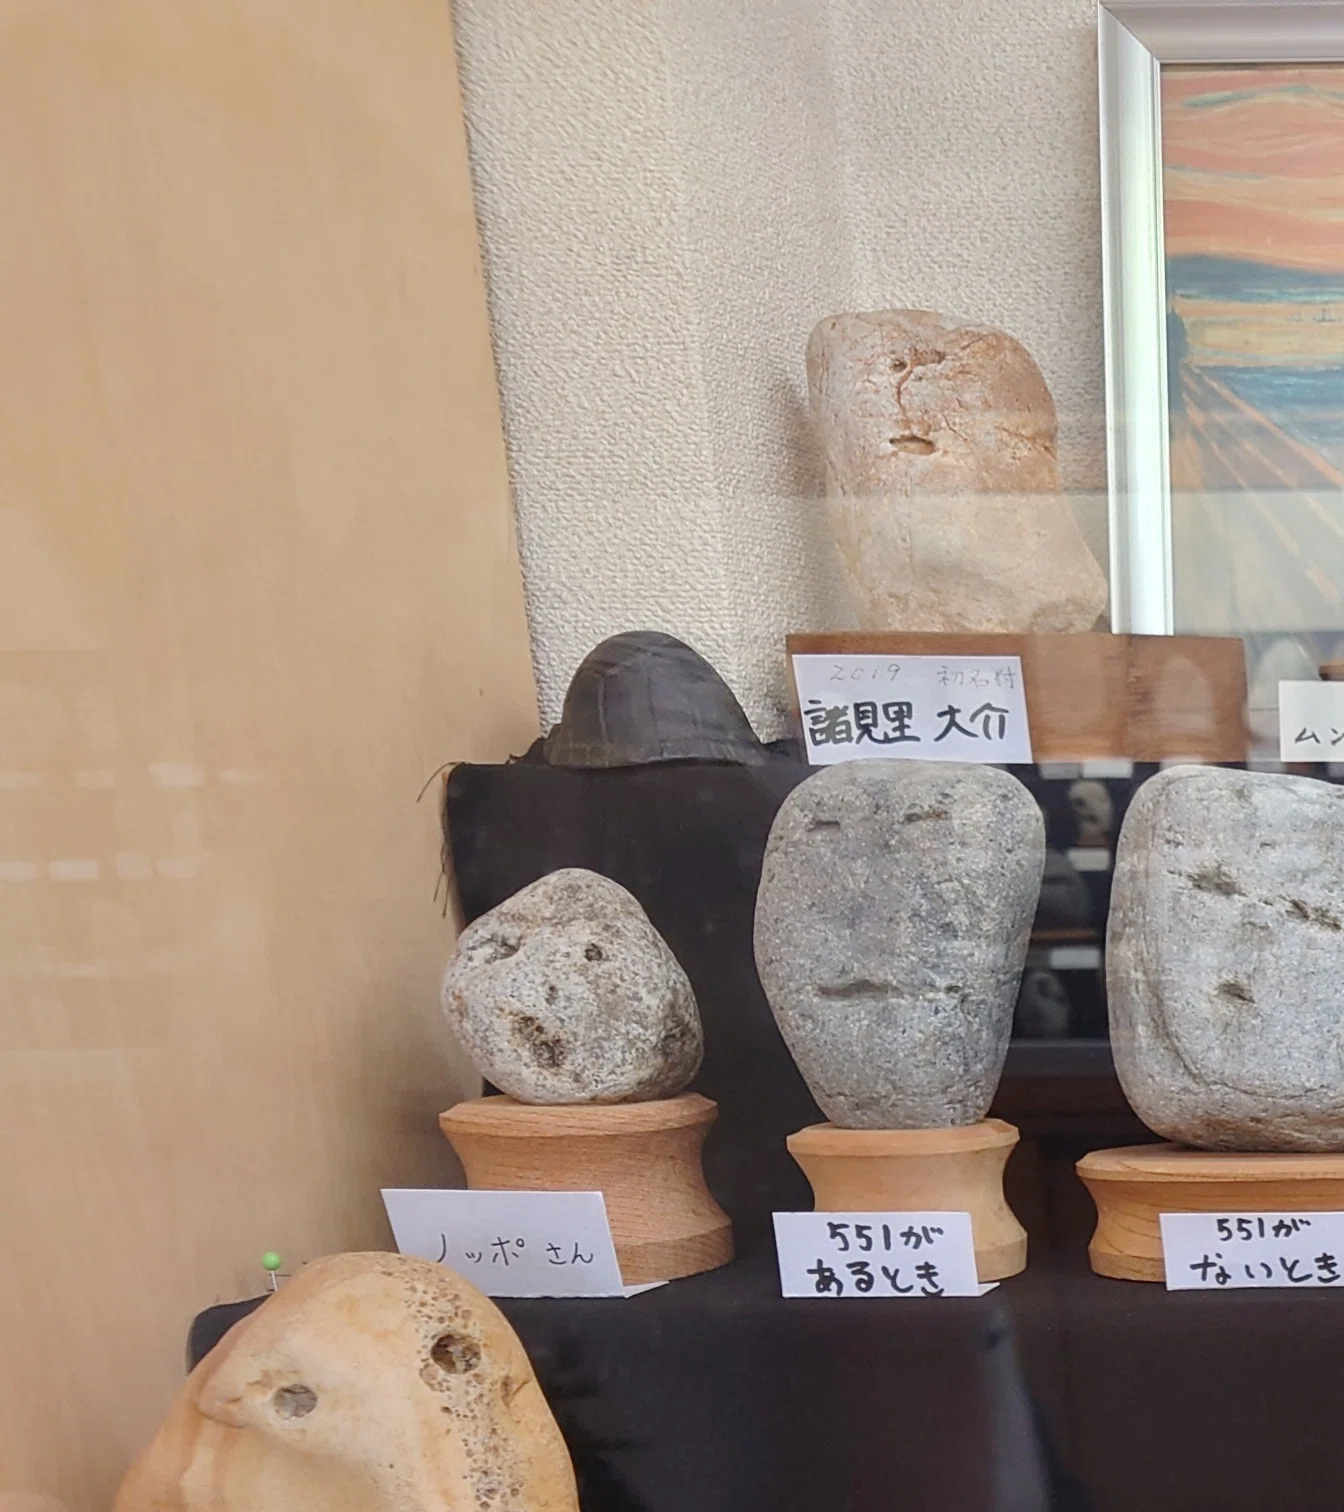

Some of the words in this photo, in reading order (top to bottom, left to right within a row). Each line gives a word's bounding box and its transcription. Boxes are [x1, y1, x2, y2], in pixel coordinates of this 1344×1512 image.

[829, 664, 901, 681] 2019
[804, 700, 921, 746] 諸見里
[934, 703, 1009, 742] 大介
[827, 1222, 944, 1251] 551が
[1216, 1218, 1311, 1241] 551が
[807, 1259, 944, 1296] あるとき
[1190, 1253, 1341, 1285] ないとき
